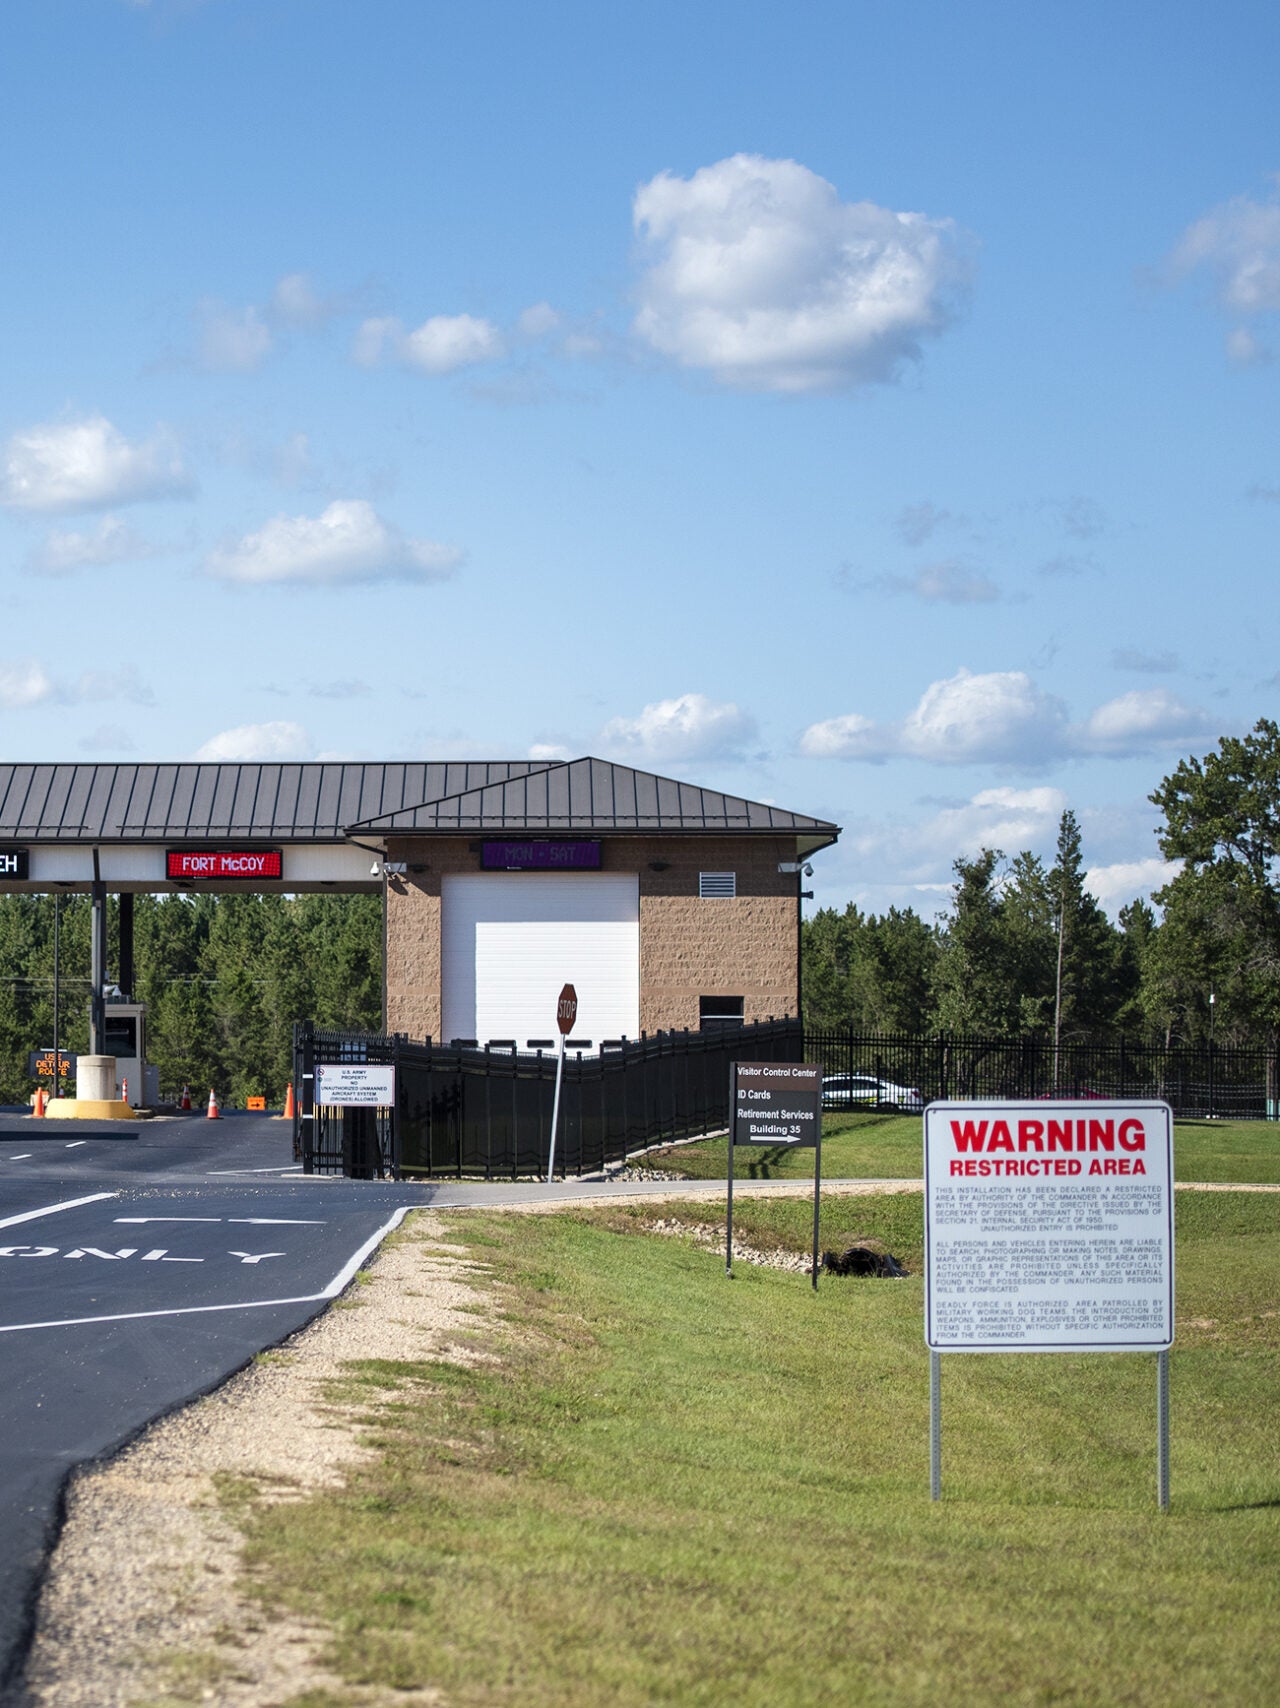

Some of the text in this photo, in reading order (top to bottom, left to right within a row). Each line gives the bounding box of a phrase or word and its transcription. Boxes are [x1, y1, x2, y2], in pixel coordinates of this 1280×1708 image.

[505, 847, 533, 860] MON
[551, 847, 576, 860] SAT
[182, 857, 265, 871] FORT McCOY
[558, 1000, 577, 1019] STOP
[737, 1067, 817, 1077] Visitor Control Center
[737, 1090, 771, 1100] ID Cards
[737, 1108, 814, 1120] Retirement Services
[750, 1125, 801, 1135] Building 35
[950, 1118, 1146, 1152] WARNING
[950, 1158, 1146, 1176] RESTRICTED AREA
[935, 1186, 954, 1194] THIS
[1014, 1186, 1032, 1194] HAS
[934, 1194, 957, 1202] AREA
[1099, 1193, 1109, 1201] IN
[1027, 1201, 1038, 1209] OF
[1041, 1201, 1057, 1209] THE
[1147, 1200, 1163, 1208] THE
[980, 1209, 992, 1217] OF
[1074, 1208, 1085, 1216] TO
[1088, 1208, 1102, 1216] THE
[1151, 1208, 1163, 1216] OF
[1019, 1216, 1055, 1224] SECURITY
[1056, 1216, 1072, 1224] ACT
[1072, 1216, 1084, 1224] OF
[1038, 1224, 1064, 1232] ENTRY
[1010, 1239, 1046, 1247] VEHICLES
[1048, 1239, 1087, 1247] ENTERING
[936, 1247, 947, 1255] TO
[1081, 1254, 1093, 1262] OF
[1094, 1254, 1113, 1262] THIS
[1114, 1254, 1136, 1262] AREA
[988, 1262, 1005, 1270] ARE
[989, 1270, 1002, 1278] BY
[1080, 1269, 1097, 1277] ANY
[1099, 1269, 1122, 1277] SUCH
[1124, 1269, 1164, 1277] MATERIAL
[1049, 1277, 1061, 1285] OF
[971, 1300, 1001, 1308] FORCE
[935, 1308, 972, 1316] MILITARY
[976, 1308, 1015, 1316] WORKING
[1152, 1307, 1164, 1315] OF
[1078, 1315, 1091, 1323] OR
[1092, 1315, 1118, 1323] OTHER
[1024, 1323, 1061, 1331] WITHOUT
[935, 1331, 976, 1339] FROM THE
